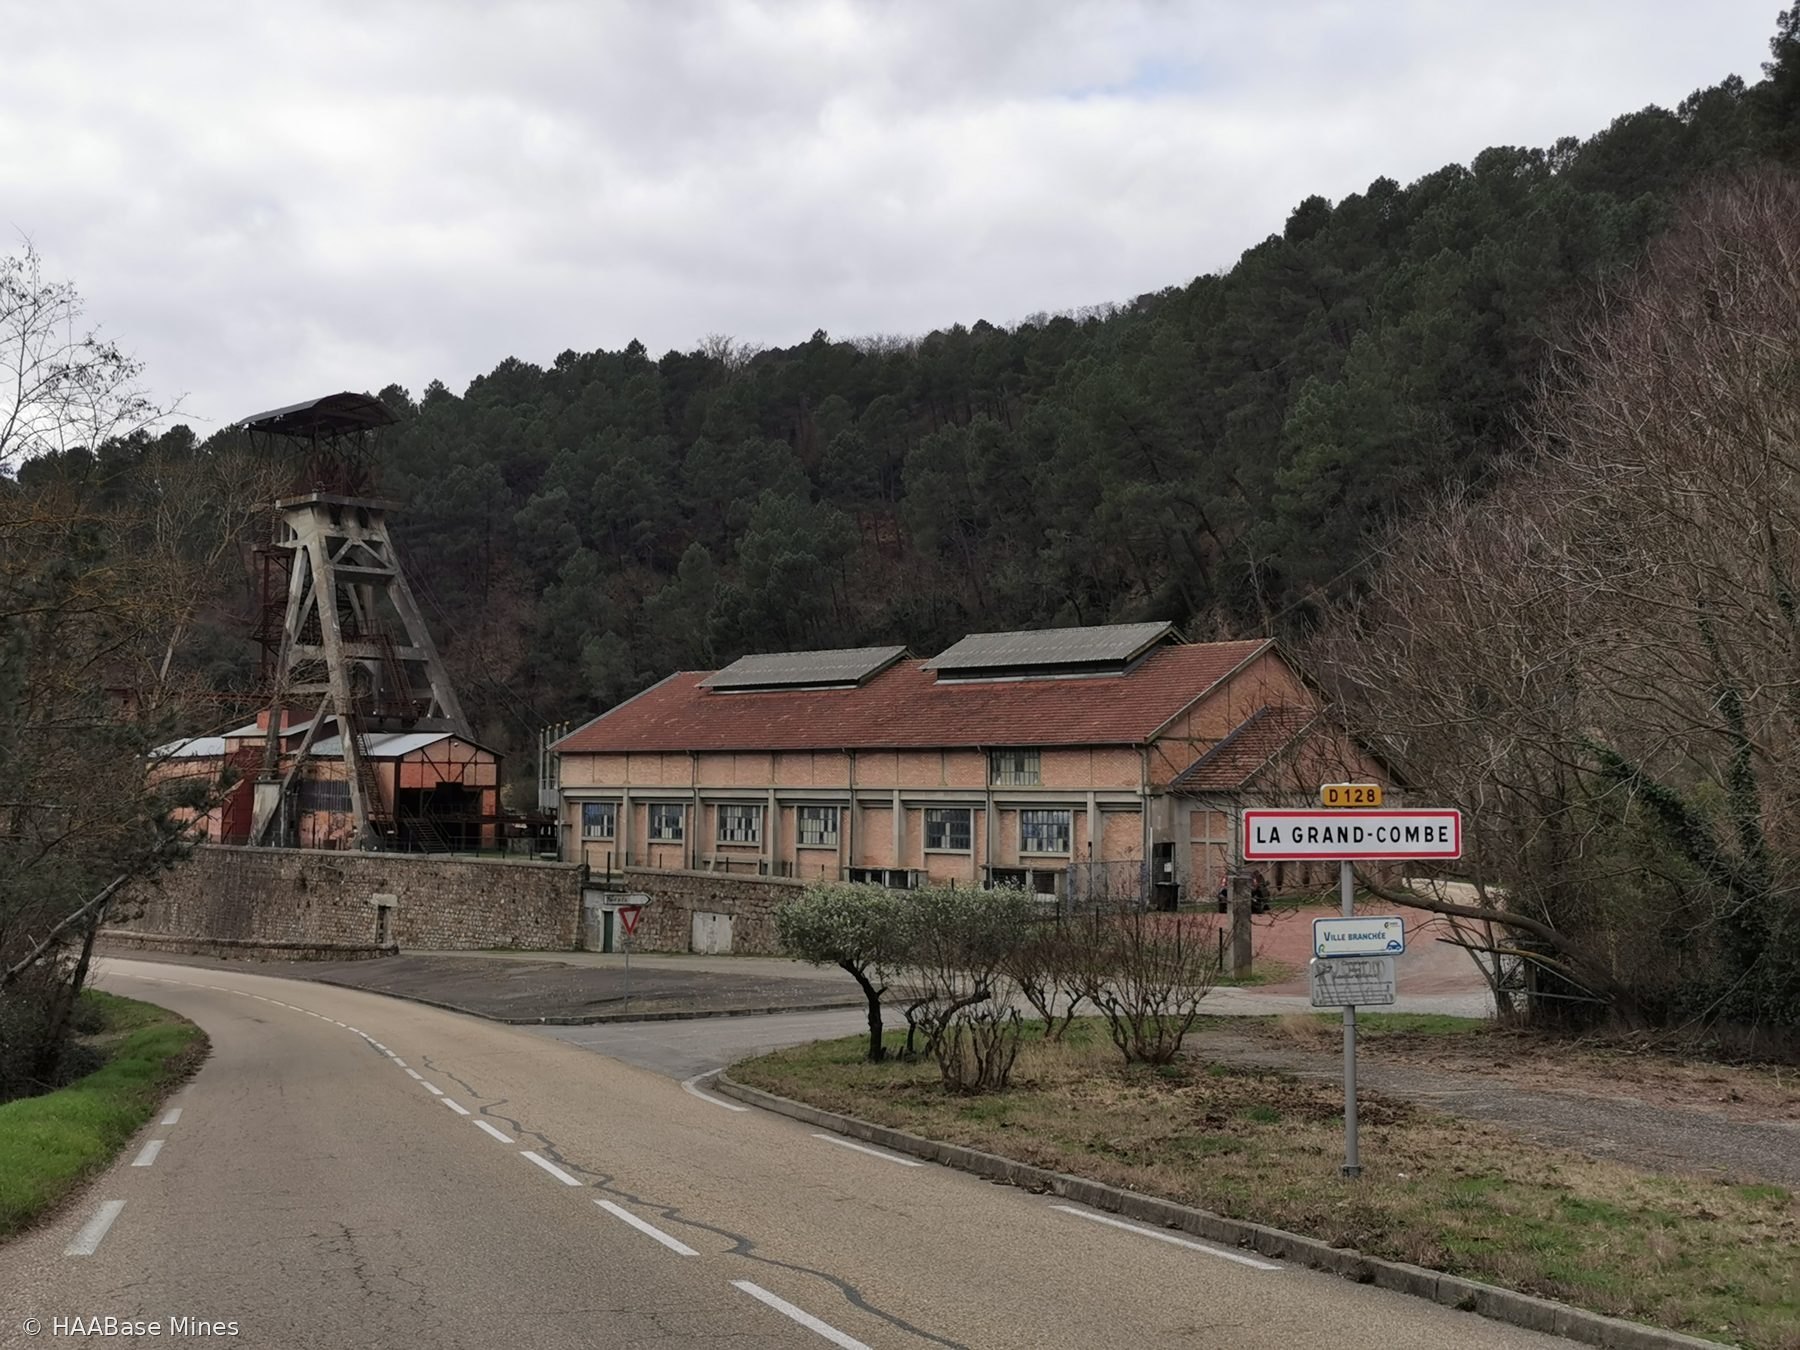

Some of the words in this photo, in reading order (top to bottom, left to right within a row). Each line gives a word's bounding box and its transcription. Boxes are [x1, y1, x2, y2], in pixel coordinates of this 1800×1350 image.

[1329, 788, 1338, 802] D
[1344, 788, 1376, 802] 128
[1256, 826, 1281, 844] LA
[1292, 825, 1448, 843] GRAND-COMBE
